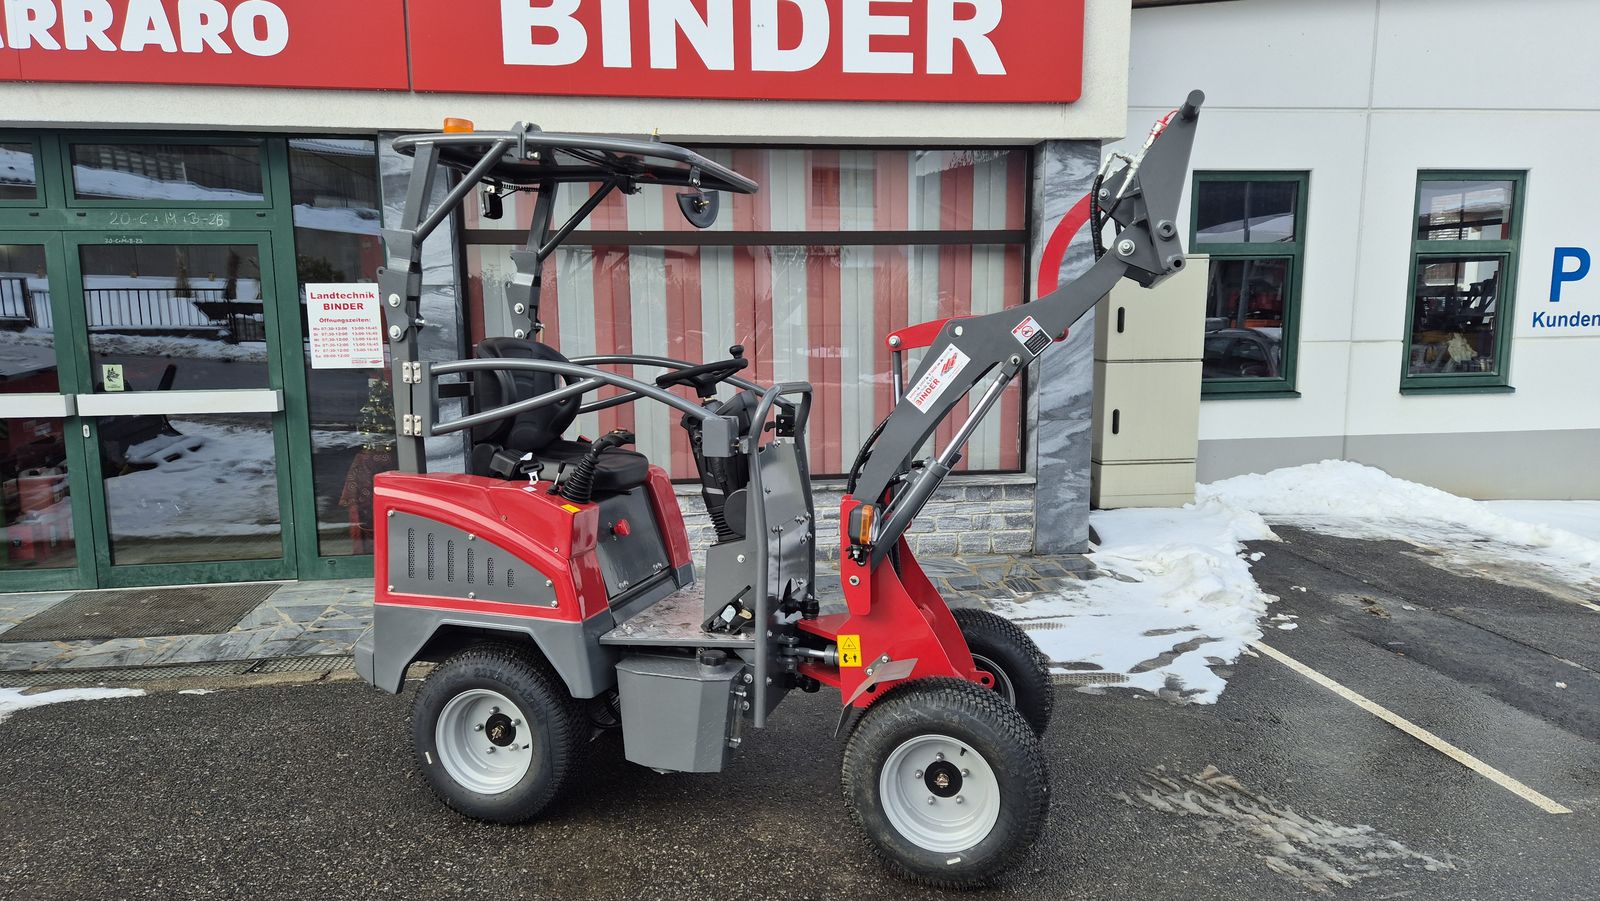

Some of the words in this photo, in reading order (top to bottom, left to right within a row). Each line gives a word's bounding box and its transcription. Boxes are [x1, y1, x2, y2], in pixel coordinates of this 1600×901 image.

[0, 0, 289, 57] RRARO
[499, 0, 1008, 76] BINDER
[1549, 247, 1591, 302] P
